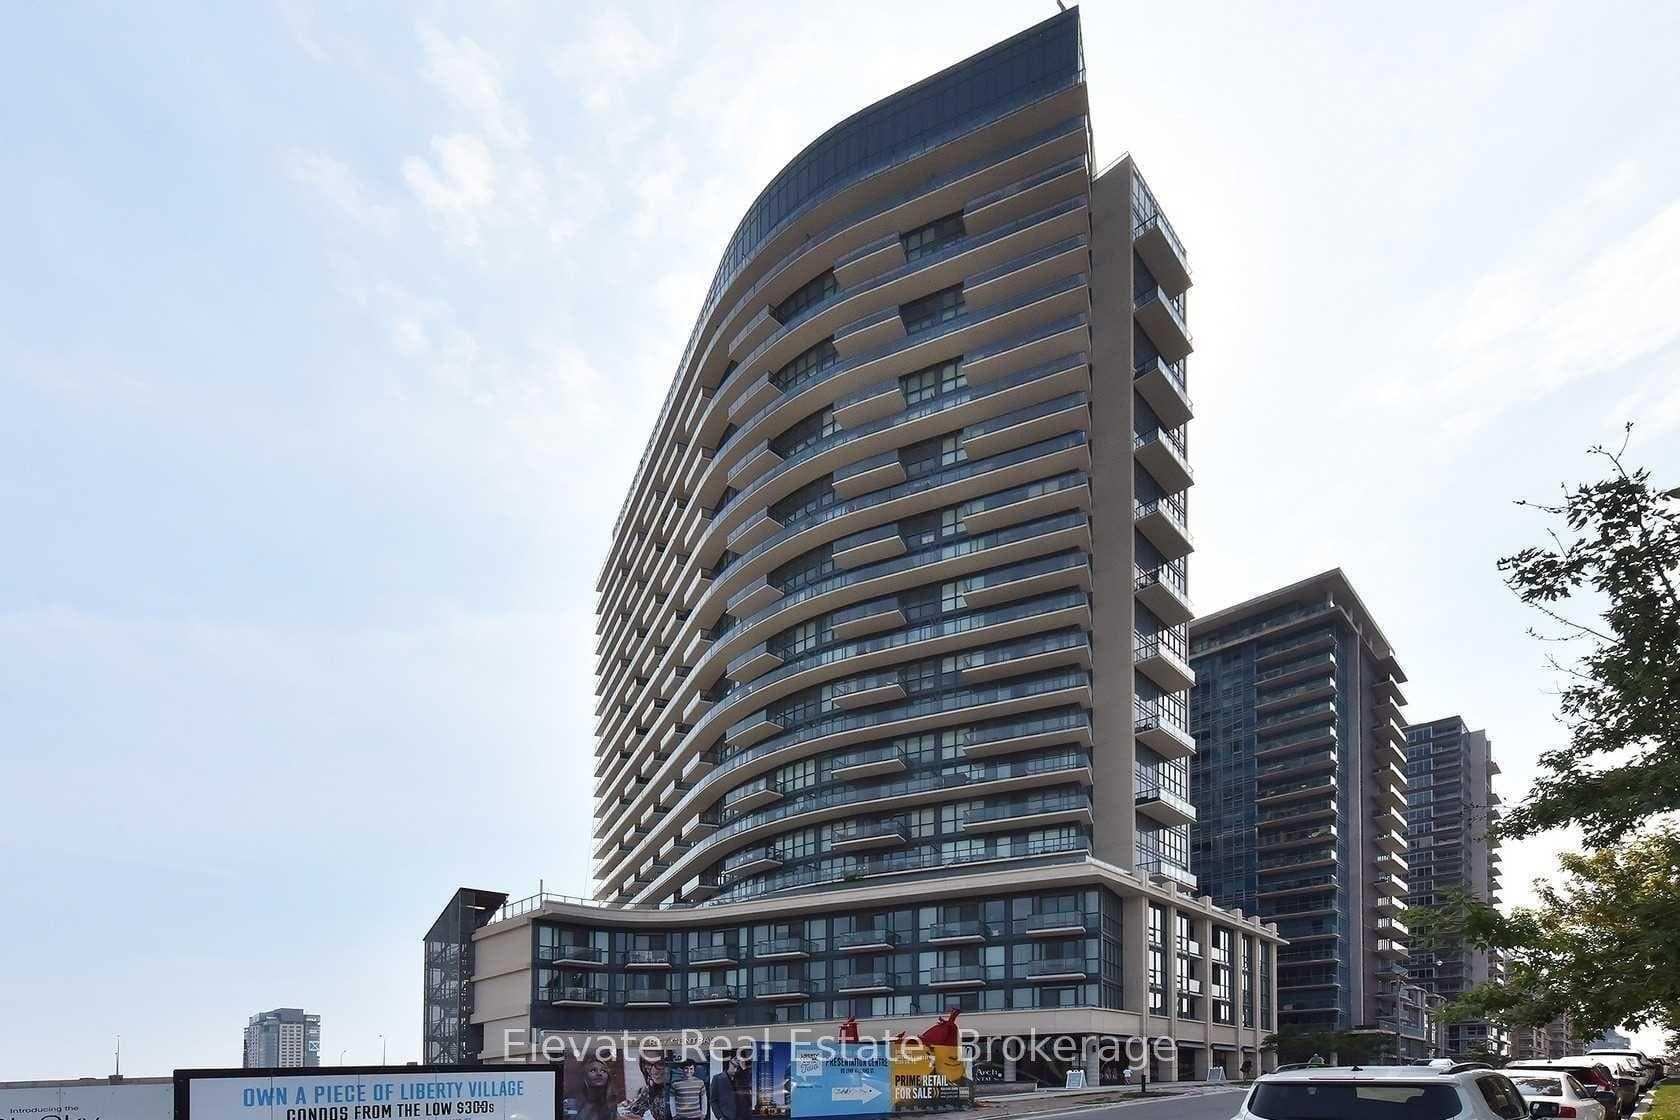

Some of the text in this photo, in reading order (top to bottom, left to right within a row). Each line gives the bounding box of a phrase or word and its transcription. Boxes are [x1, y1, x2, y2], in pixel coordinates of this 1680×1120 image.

[895, 1075, 949, 1086] PRIME RETAIL
[243, 1080, 524, 1107] OWN A PIECE OF LIBERTY VILLAGE
[895, 1087, 911, 1099] FOR
[913, 1087, 933, 1099] SALE
[10, 1104, 62, 1114] Introducing
[286, 1106, 349, 1120] CONDOS
[354, 1104, 392, 1119] FROM
[397, 1103, 420, 1118] THE
[425, 1102, 453, 1117] LOW
